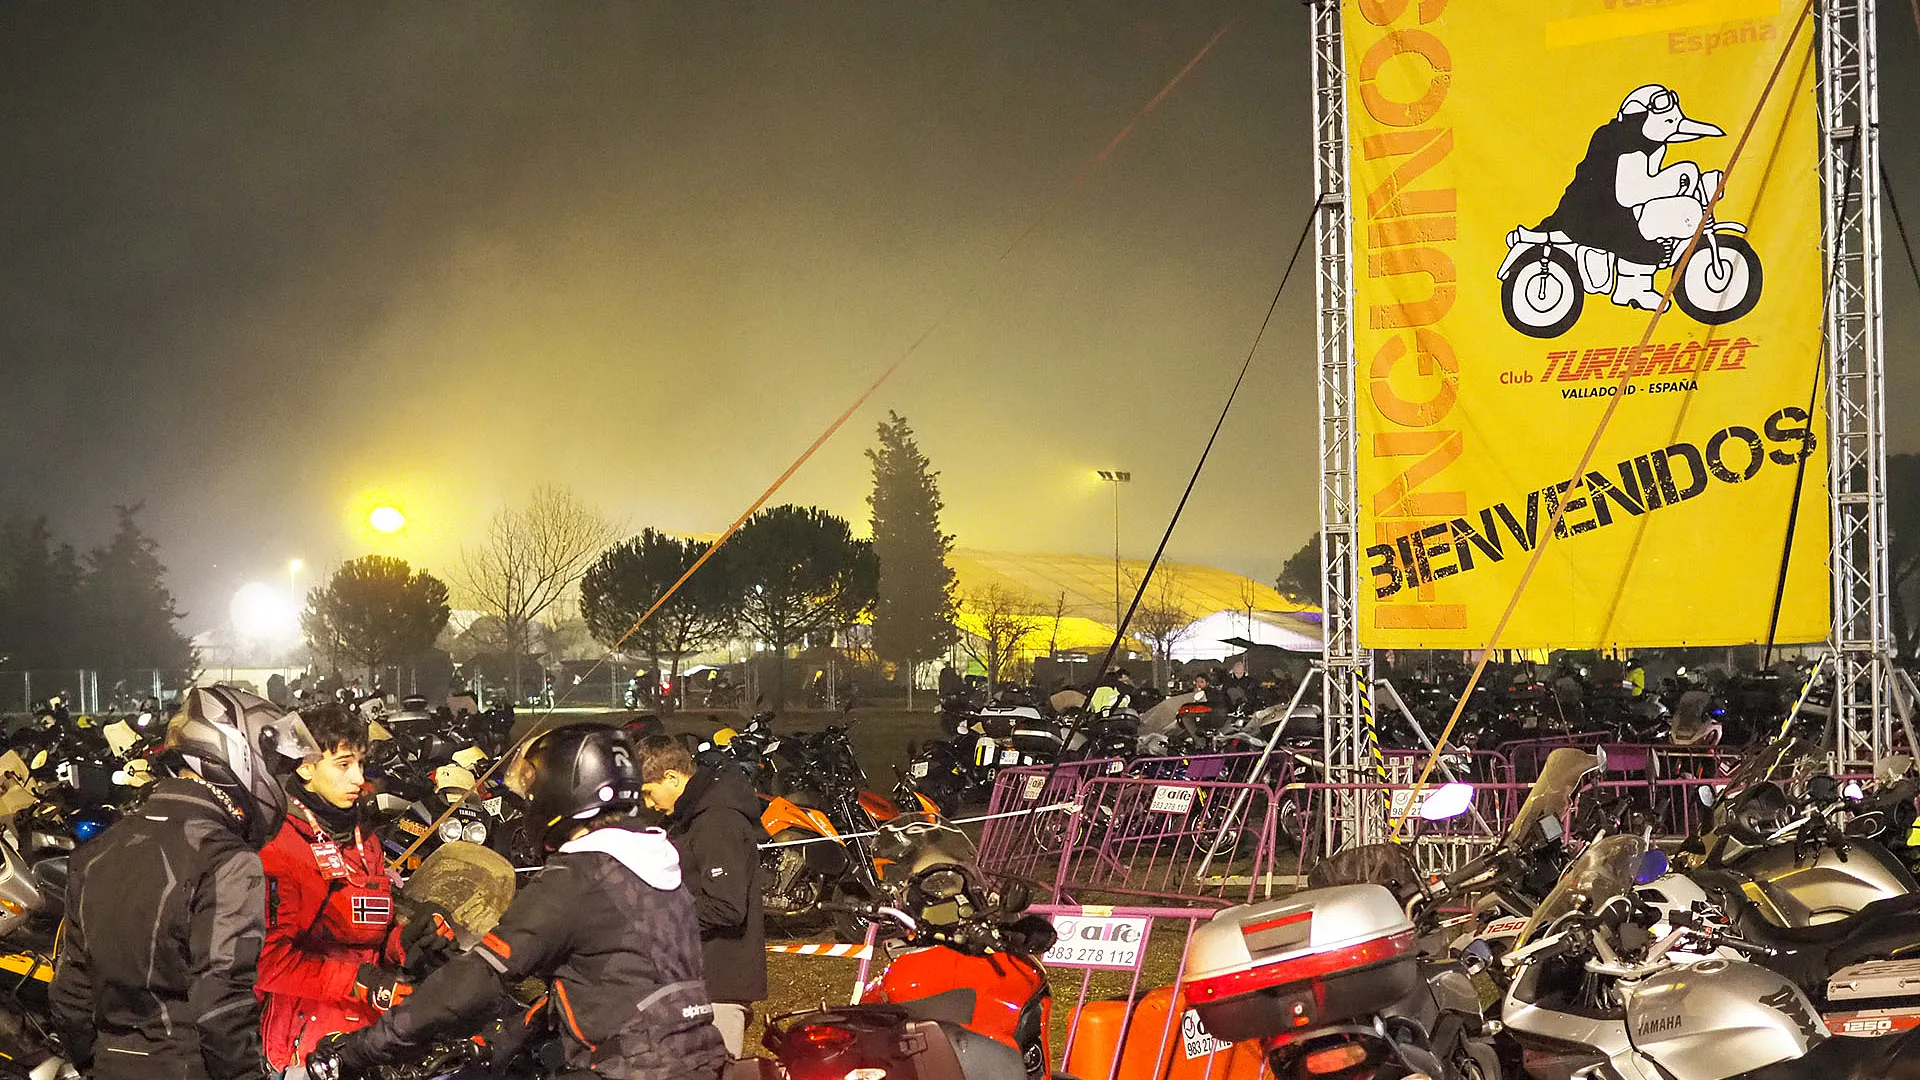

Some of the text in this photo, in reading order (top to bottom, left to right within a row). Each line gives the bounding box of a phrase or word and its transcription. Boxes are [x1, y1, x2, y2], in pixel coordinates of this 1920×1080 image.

[1667, 20, 1777, 55] España
[1499, 337, 1760, 385] Club TURISMOTO
[1561, 384, 1636, 399] VALLADOID
[1648, 378, 1698, 393] ESPAÑA
[1366, 406, 1818, 599] BIENVENIDOS
[1167, 790, 1191, 801] alfe
[1392, 807, 1404, 816] 98
[1080, 923, 1141, 943] alfe
[1487, 921, 1526, 933] 1250
[1047, 947, 1134, 964] 983 278 112
[1638, 1014, 1682, 1037] YAMAHA
[1843, 1020, 1892, 1033] 1250
[1187, 1040, 1202, 1056] 983
[1202, 1037, 1214, 1052] 27
